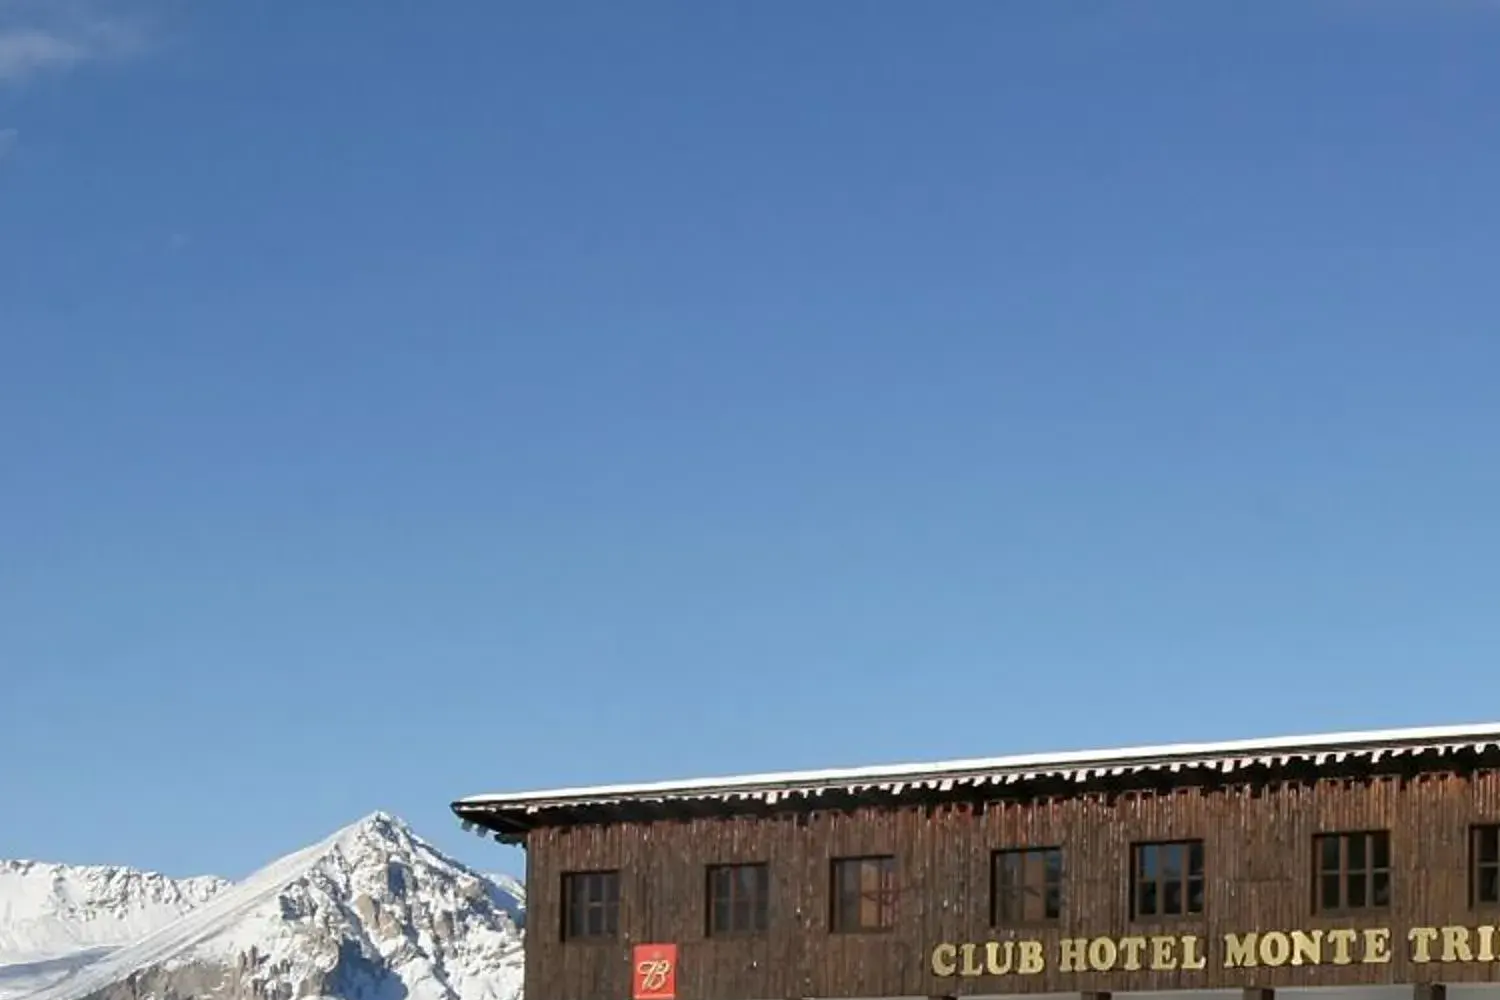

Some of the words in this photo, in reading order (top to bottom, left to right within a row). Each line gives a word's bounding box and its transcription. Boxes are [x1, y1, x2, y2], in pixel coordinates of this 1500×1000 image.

[932, 941, 1044, 976] CLUB
[1059, 935, 1206, 971] HOTEL
[1224, 928, 1391, 966] MONTE
